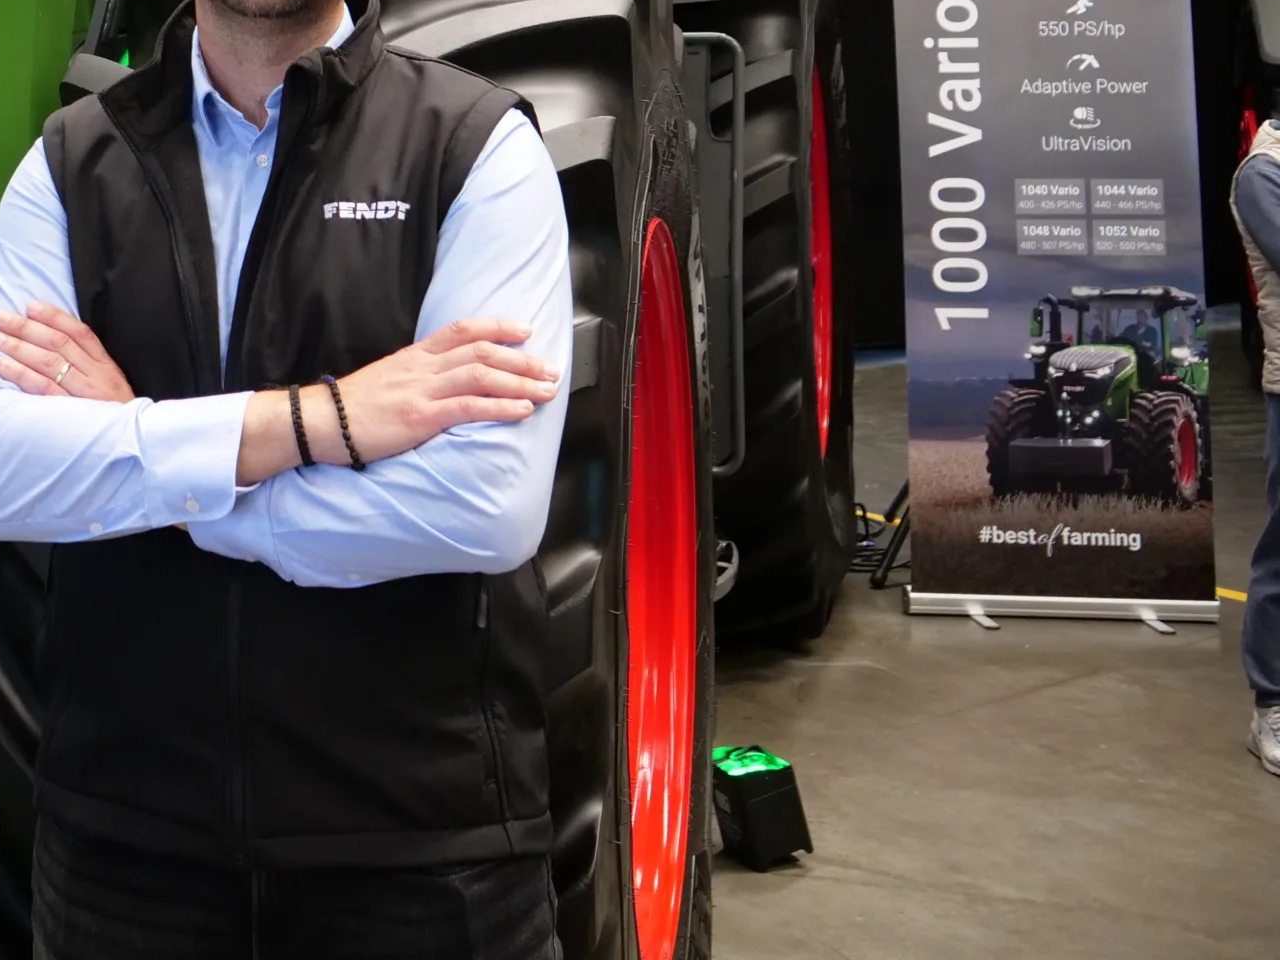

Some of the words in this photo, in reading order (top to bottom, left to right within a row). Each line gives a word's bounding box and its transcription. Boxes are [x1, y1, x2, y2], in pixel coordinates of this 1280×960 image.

[1038, 21, 1069, 37] 550
[1074, 20, 1125, 39] PS/hp
[1020, 78, 1092, 97] Adaptive
[1096, 78, 1149, 94] Power
[1041, 135, 1132, 151] UltraVision
[1021, 184, 1048, 196] 1040
[1050, 184, 1080, 196] Vario
[1097, 184, 1126, 196] 1044
[1128, 184, 1159, 196] Vario
[323, 200, 411, 221] FENDT
[1057, 200, 1083, 211] PS/hp
[1135, 200, 1162, 210] PS/hp
[1022, 225, 1050, 237] 1048
[1051, 225, 1082, 237] Vario
[1098, 225, 1128, 237] 1052
[1130, 225, 1160, 237] Vario
[1058, 241, 1085, 251] PS/hp
[1137, 241, 1163, 252] PS/hp
[928, 177, 989, 331] 1000
